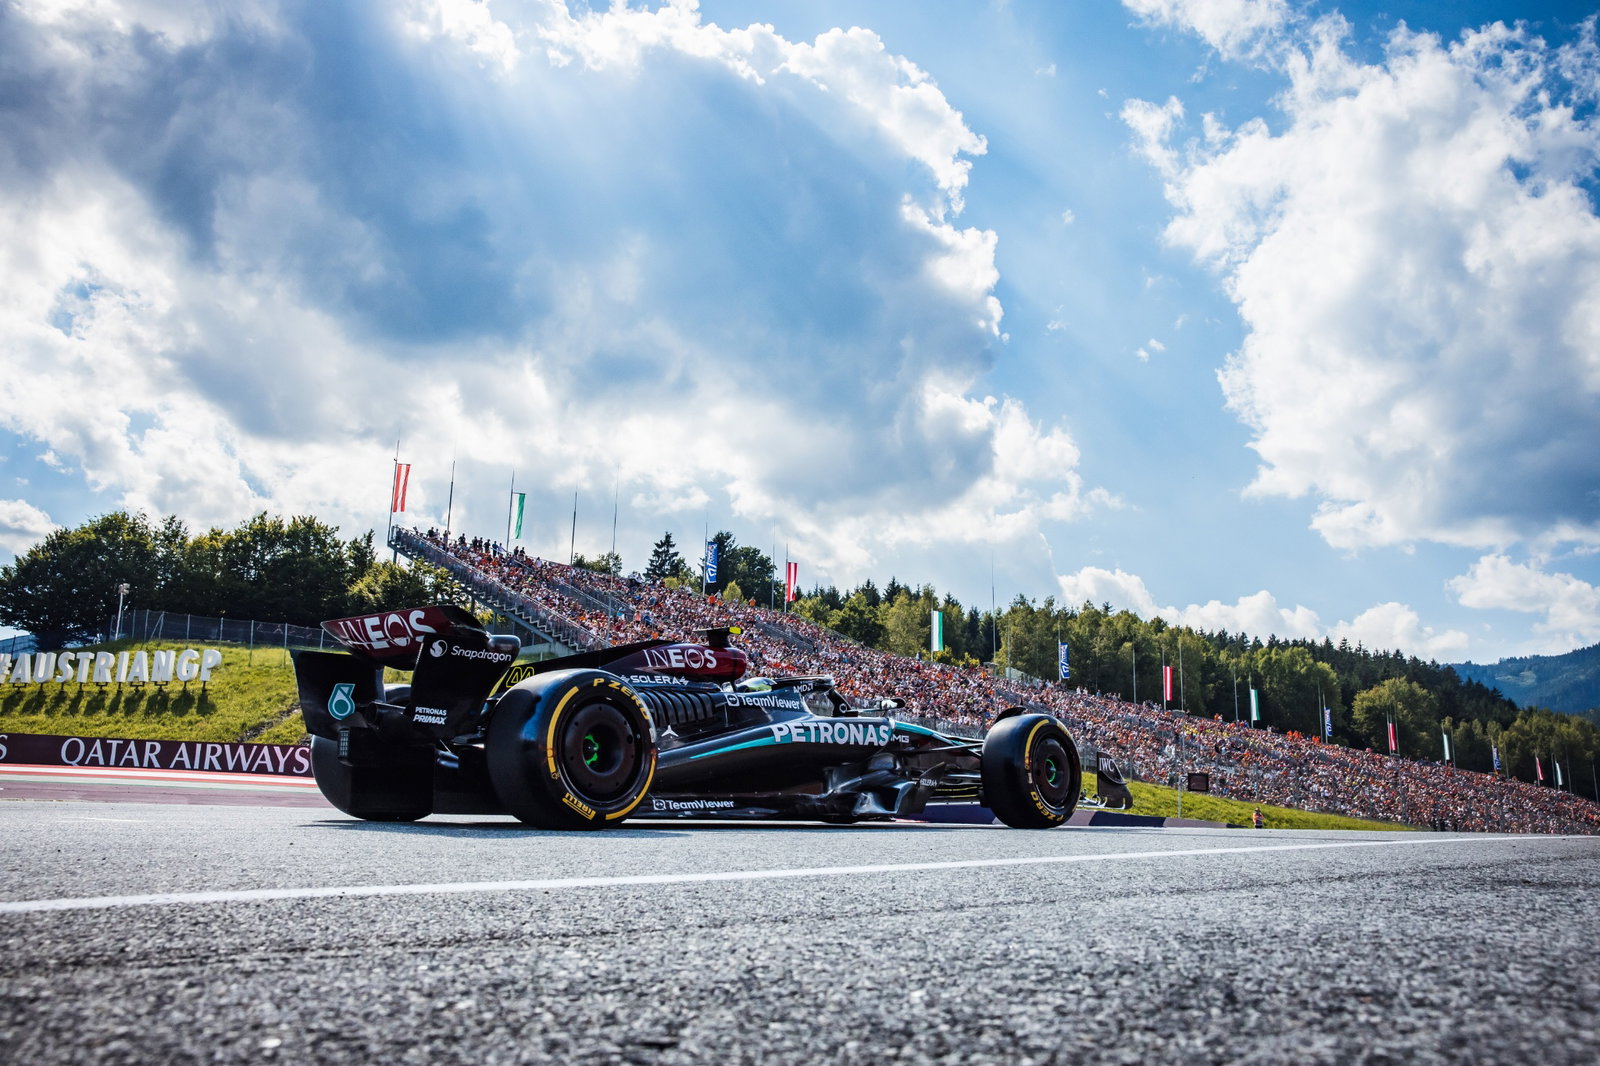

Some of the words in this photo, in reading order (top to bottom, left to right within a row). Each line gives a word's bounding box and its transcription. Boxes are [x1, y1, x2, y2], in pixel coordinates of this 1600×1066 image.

[338, 610, 437, 650] INEOS
[451, 645, 512, 663] Snapdragon
[643, 648, 717, 669] INEOS
[593, 678, 605, 687] P
[630, 675, 681, 685] SOLERA
[740, 695, 800, 710] TeamViewer
[415, 706, 447, 716] PETRONAS
[412, 714, 447, 725] PRIMAX
[771, 722, 889, 746] PETRONAS
[891, 734, 910, 744] MG
[60, 737, 161, 769] QATAR
[169, 742, 310, 774] AIRWAYS
[562, 792, 596, 820] PIRELLI
[665, 799, 735, 810] TeamViewer
